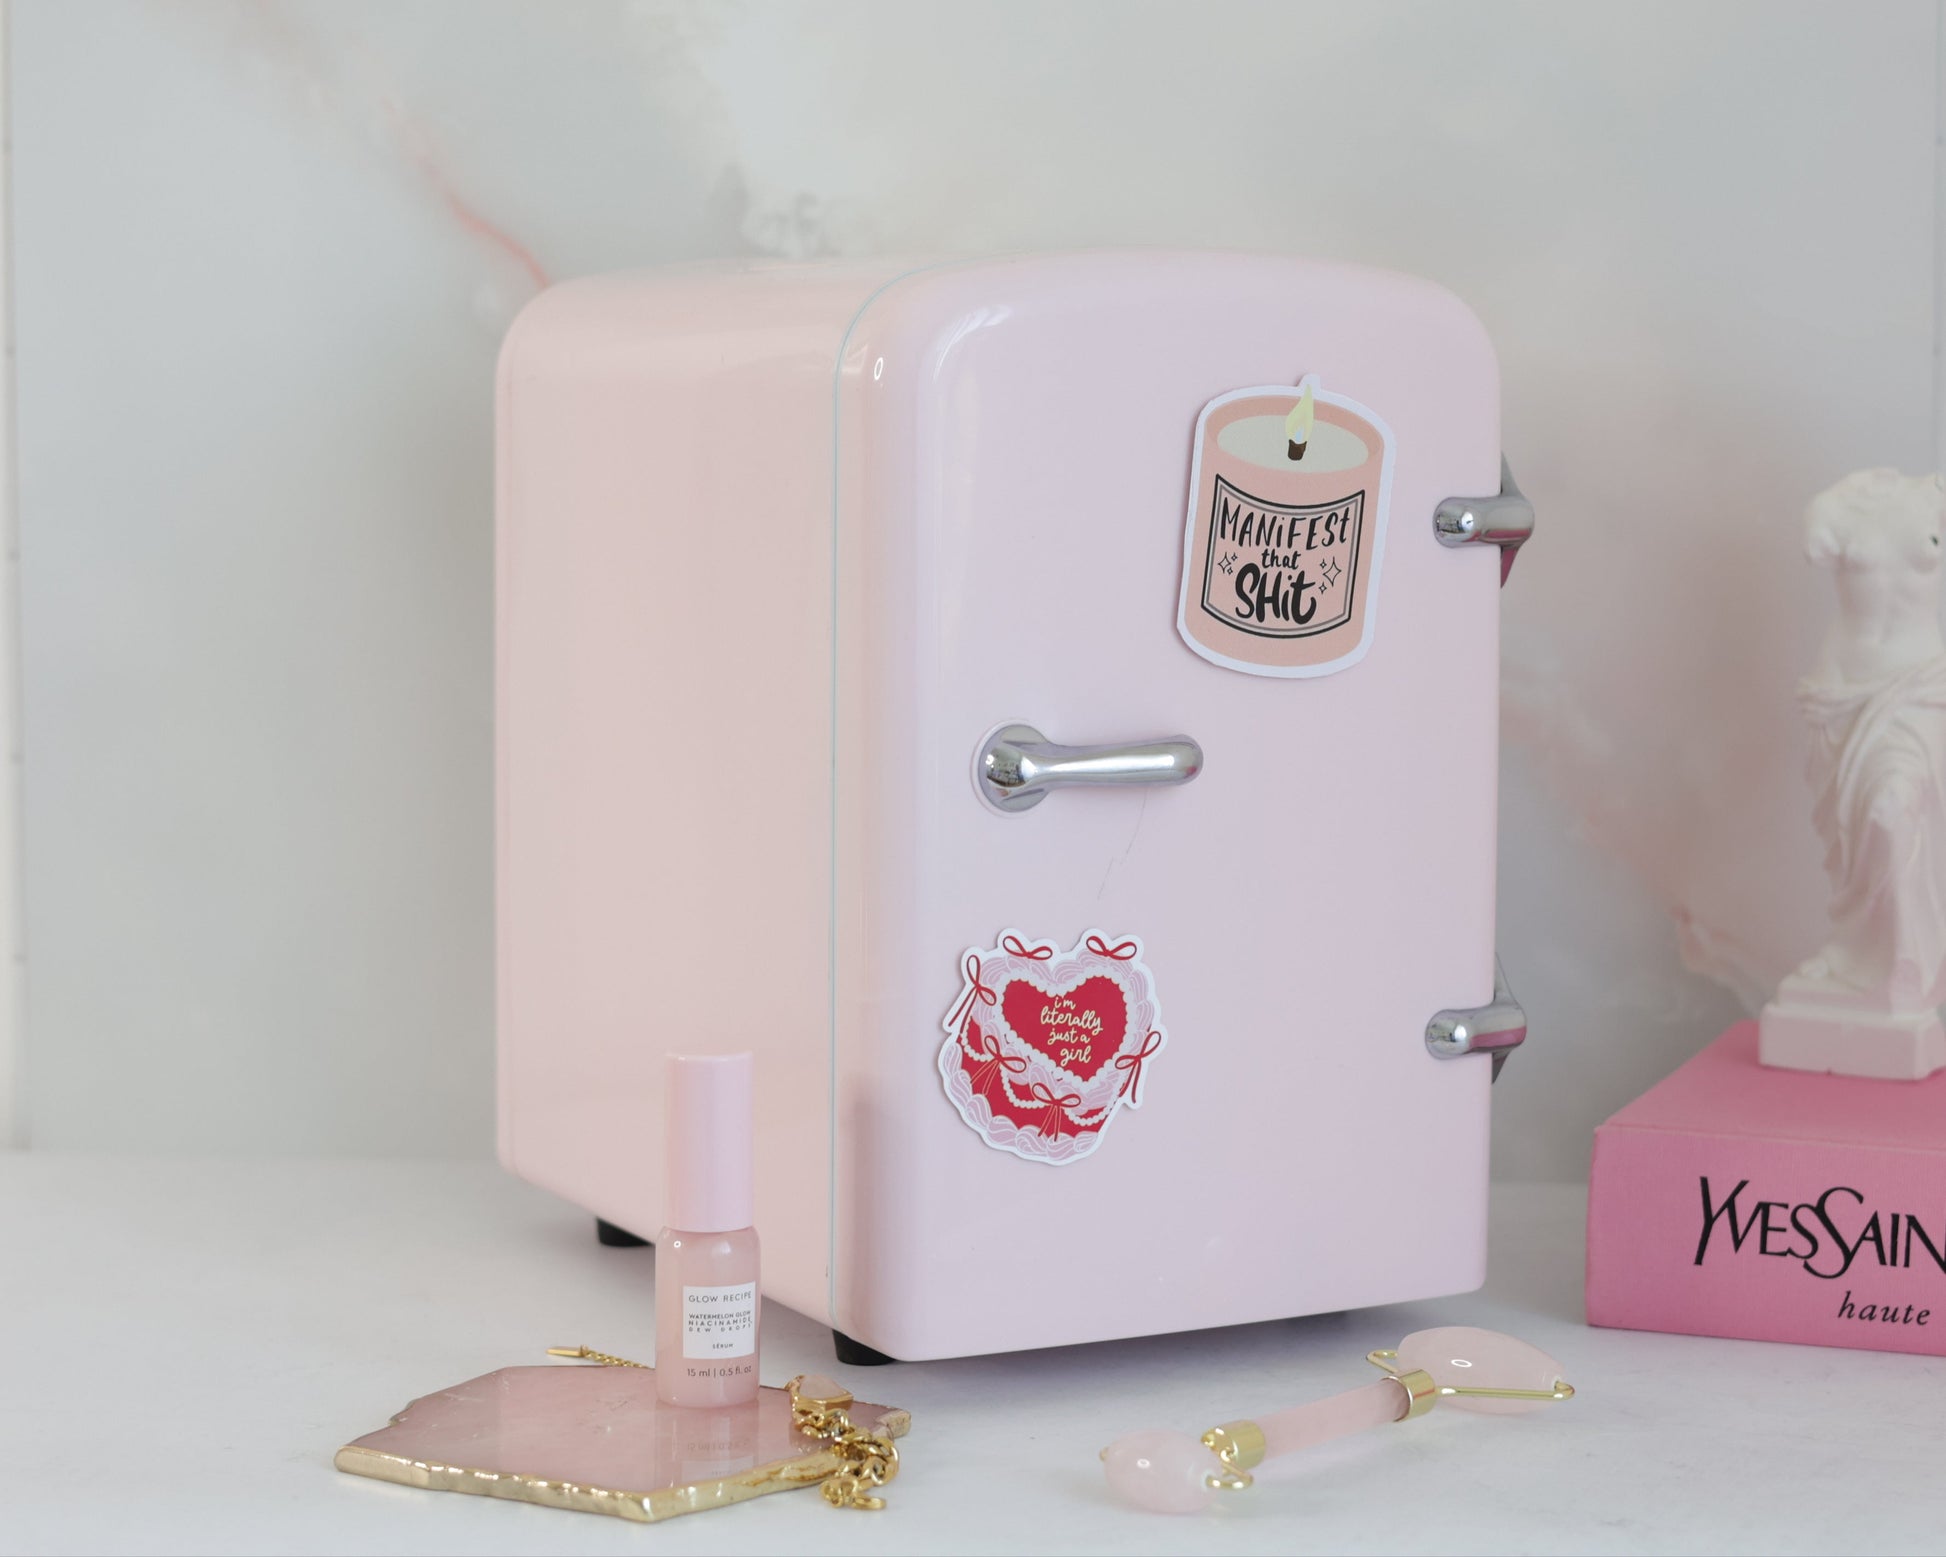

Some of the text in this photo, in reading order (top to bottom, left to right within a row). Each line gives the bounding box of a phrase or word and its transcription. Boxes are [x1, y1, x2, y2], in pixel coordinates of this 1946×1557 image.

[1261, 548, 1301, 570] that
[1235, 562, 1317, 625] SHit
[1040, 1006, 1104, 1036] literally
[1047, 1027, 1091, 1045] just a
[1060, 1045, 1091, 1067] girl
[688, 1291, 751, 1303] GLOW RECIPE
[735, 1310, 751, 1318] GLOW
[1838, 1290, 1930, 1326] haute
[688, 1317, 751, 1326] NIACINAMIDE
[687, 1368, 696, 1377] 15
[698, 1368, 711, 1377] ml
[719, 1367, 733, 1377] 0.5
